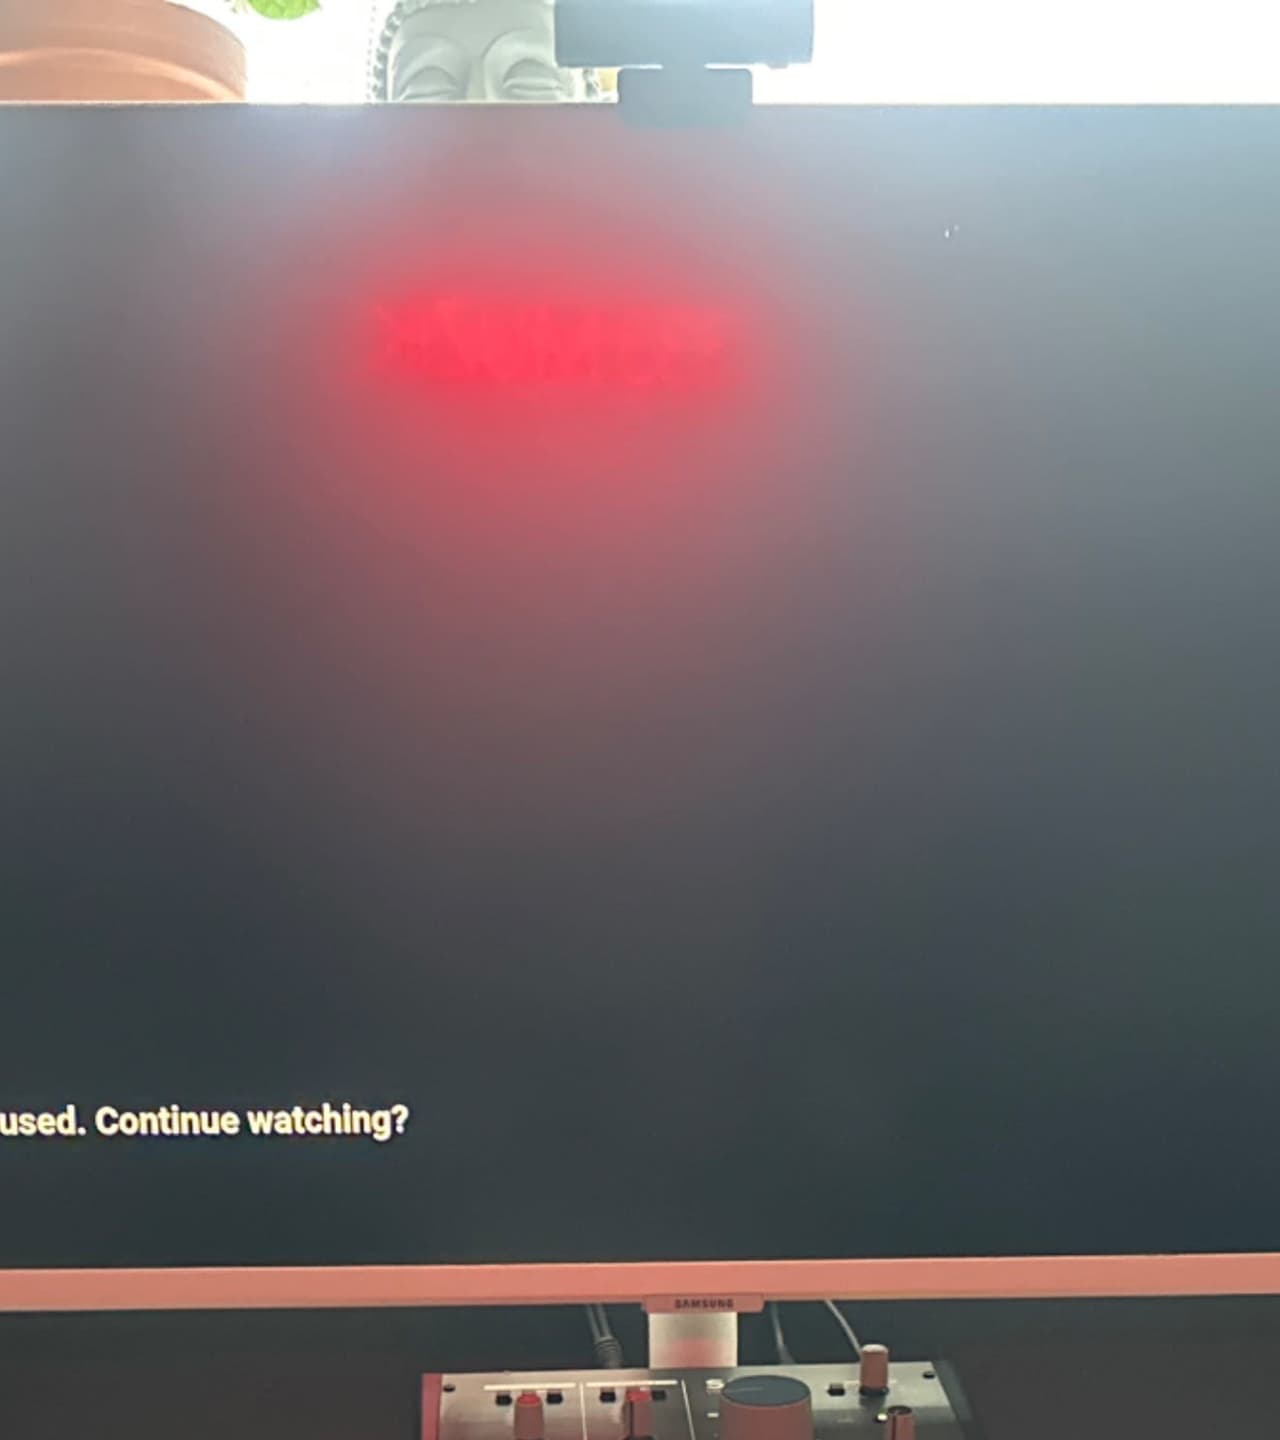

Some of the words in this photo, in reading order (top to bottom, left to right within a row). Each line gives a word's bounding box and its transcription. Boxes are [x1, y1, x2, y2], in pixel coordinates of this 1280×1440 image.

[94, 1105, 240, 1137] Continue
[247, 1102, 410, 1142] watching?
[674, 1297, 735, 1310] SAMSUNG
